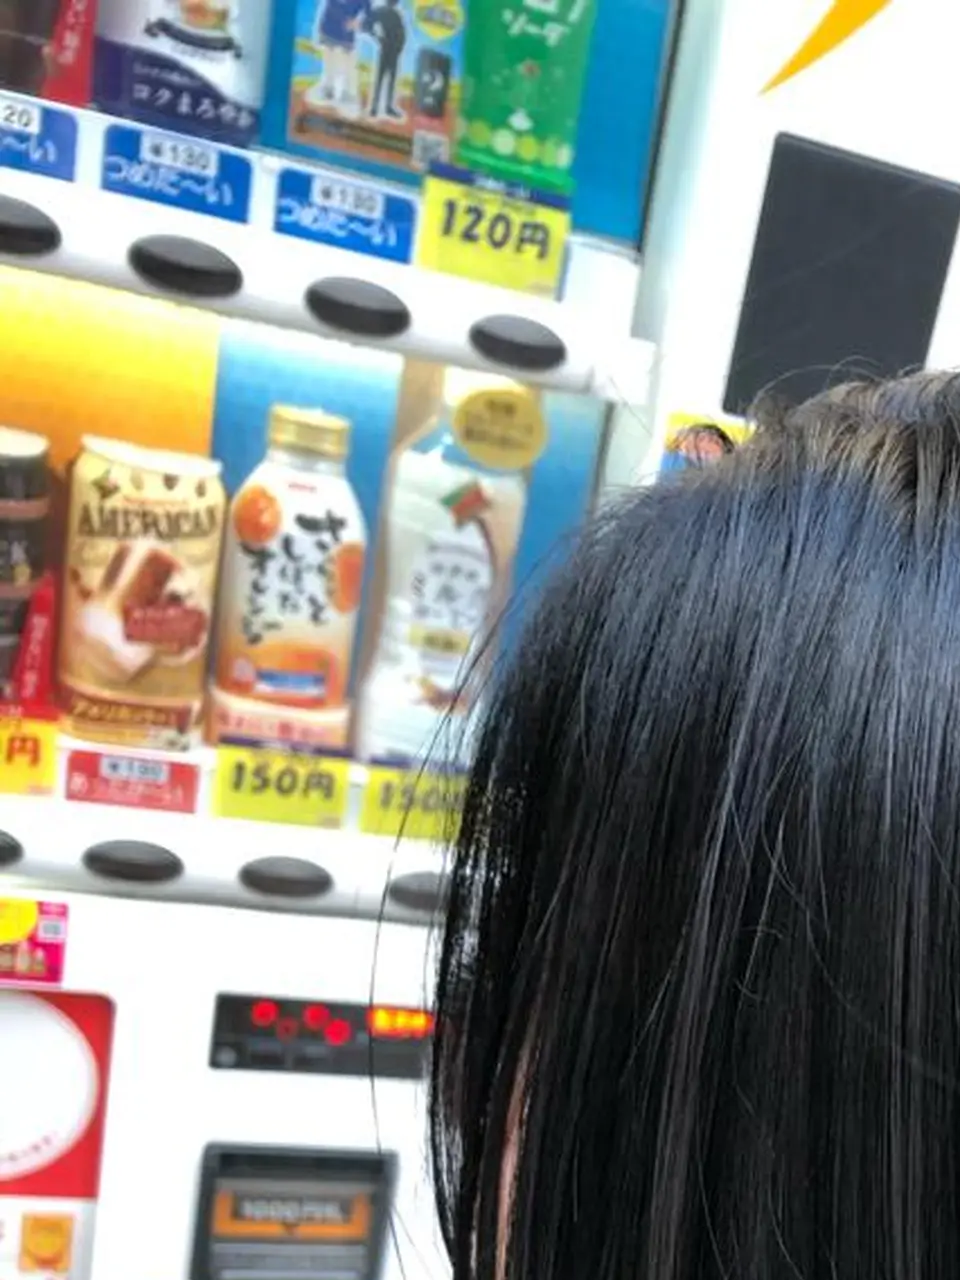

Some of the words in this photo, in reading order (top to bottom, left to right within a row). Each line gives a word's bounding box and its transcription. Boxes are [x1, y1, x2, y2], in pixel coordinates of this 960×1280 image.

[442, 199, 550, 260] 120円
[0, 734, 41, 768] 円
[230, 759, 336, 800] 150円
